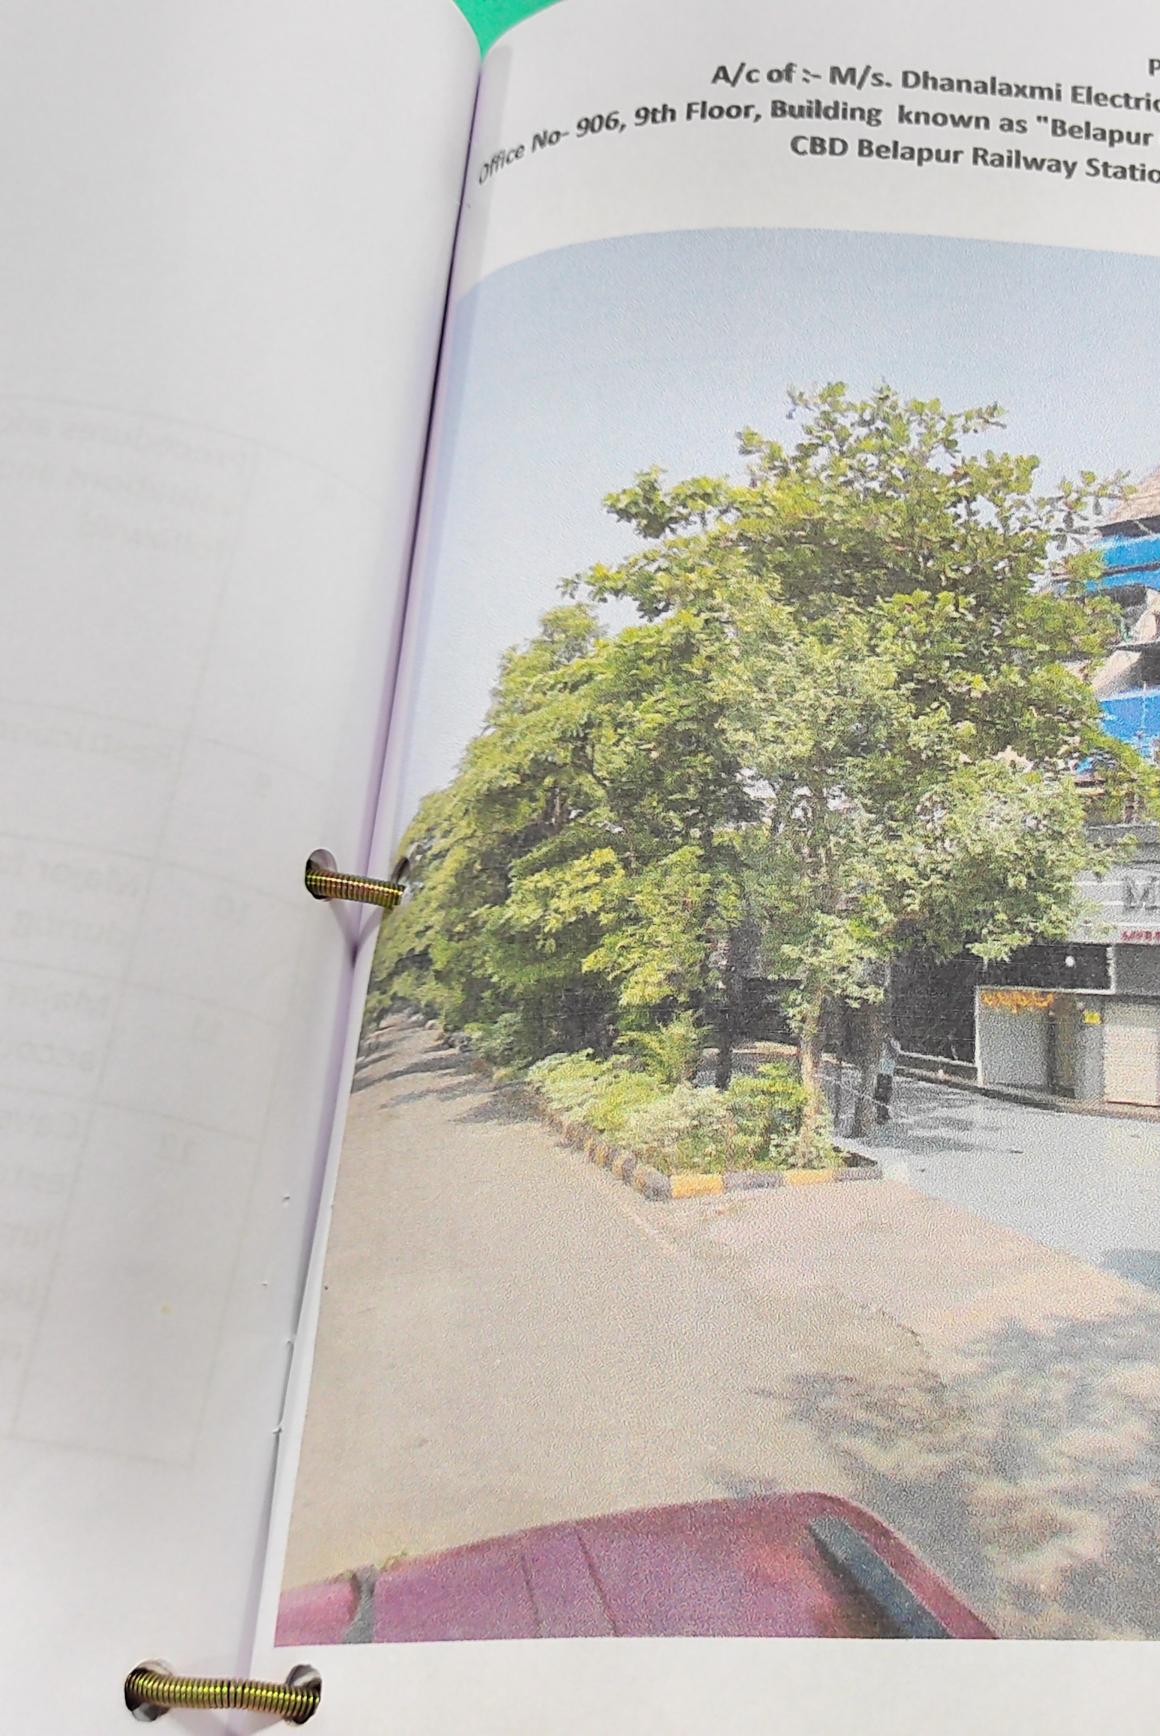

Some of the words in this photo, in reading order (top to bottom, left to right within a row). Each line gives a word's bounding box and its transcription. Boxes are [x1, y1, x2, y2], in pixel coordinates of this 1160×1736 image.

[711, 61, 761, 88] A/c
[766, 61, 798, 84] of
[829, 64, 893, 91] M/s.
[901, 70, 1062, 102] Dhanalaxmi
[478, 144, 525, 185] Office
[531, 129, 570, 149] No-
[576, 110, 627, 138] 906,
[634, 103, 677, 127] 9th
[685, 100, 762, 123] Floor,
[770, 98, 883, 128] Building
[897, 104, 991, 131] known
[998, 117, 1028, 134] as
[1036, 115, 1154, 148] "Belapur
[790, 135, 849, 157] CBD
[857, 138, 965, 167] Belapur
[972, 146, 1078, 180] Railway
